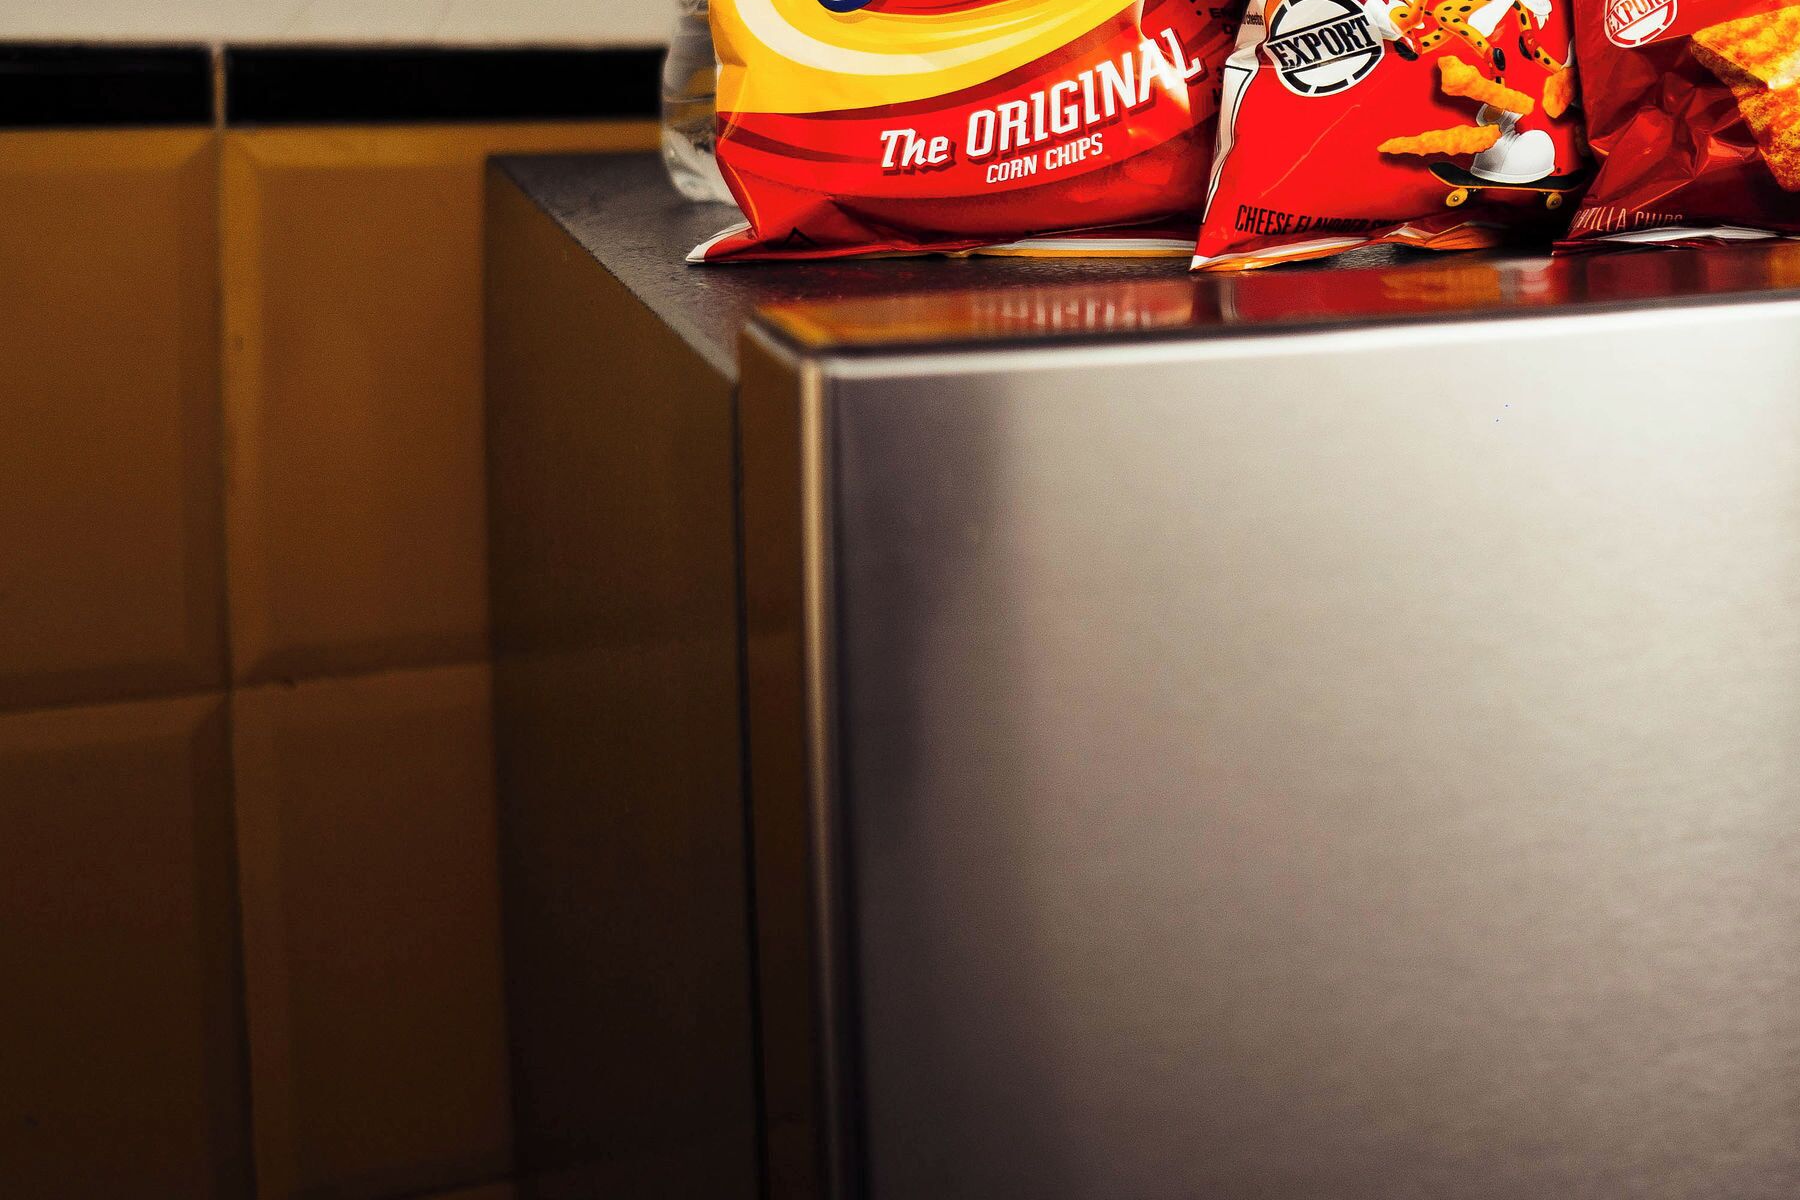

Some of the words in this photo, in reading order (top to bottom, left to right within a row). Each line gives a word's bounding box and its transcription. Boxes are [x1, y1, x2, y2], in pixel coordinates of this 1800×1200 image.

[1266, 14, 1377, 71] EXPORT
[880, 128, 948, 169] The
[966, 28, 1202, 158] ORIGINAL
[986, 154, 1038, 185] CORN
[1045, 133, 1103, 170] CHIPS
[1235, 204, 1294, 236] CHEESE
[1568, 206, 1626, 232] ORTILLA
